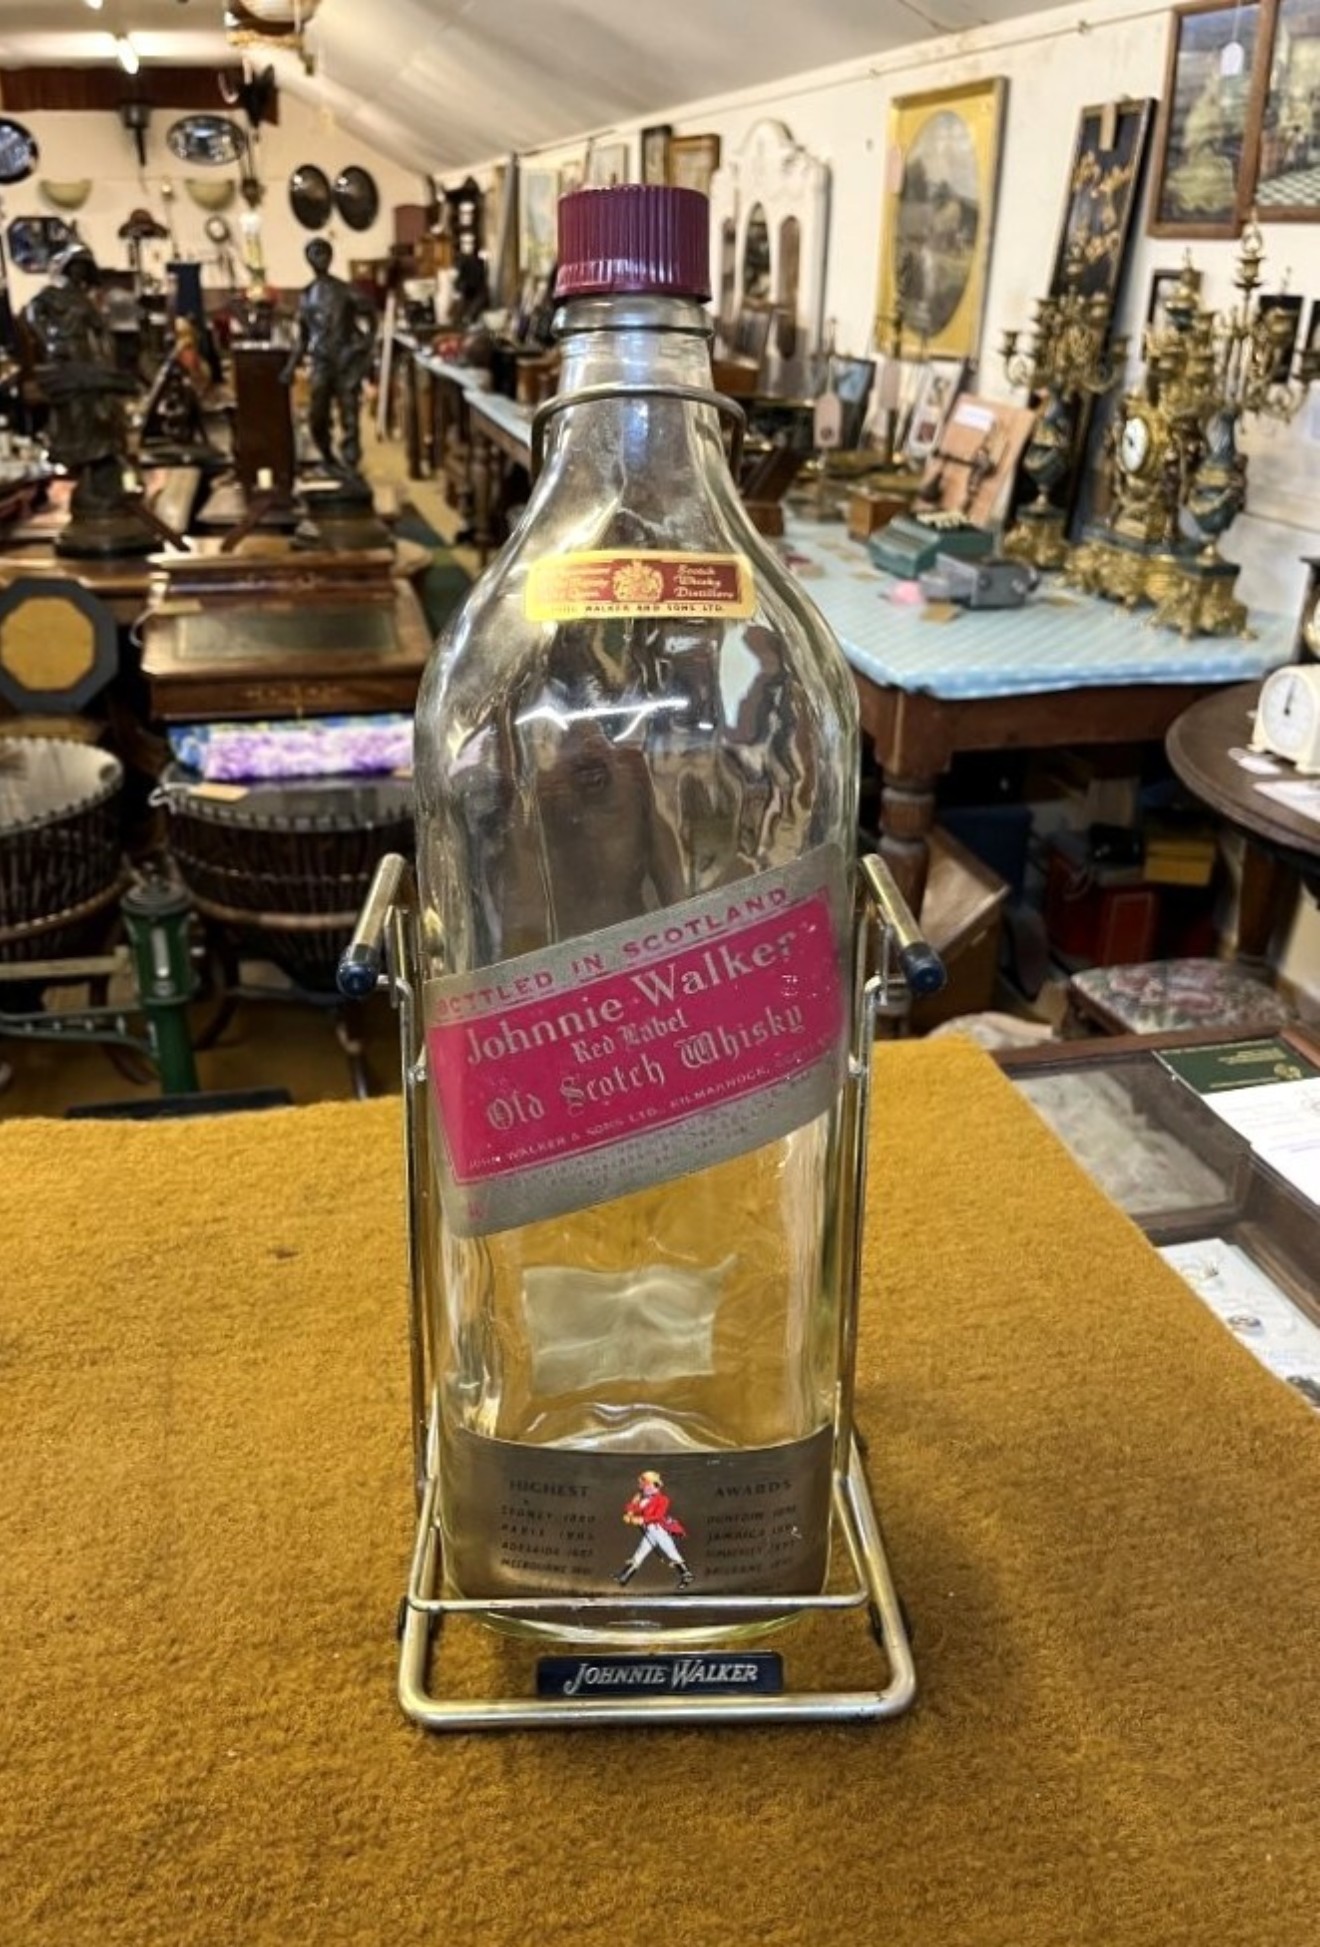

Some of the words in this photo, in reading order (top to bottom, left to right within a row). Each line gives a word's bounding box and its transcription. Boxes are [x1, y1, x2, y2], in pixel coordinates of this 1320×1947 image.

[673, 574, 721, 589] Whisky
[677, 564, 716, 575] Scotch
[573, 952, 605, 976] IN
[623, 887, 788, 958] SCOTLAND
[467, 996, 625, 1066] Johnnie
[629, 929, 797, 1008] Walker
[570, 1034, 615, 1064] Red
[617, 1008, 689, 1049] Label
[487, 1089, 546, 1131] Old
[560, 1054, 666, 1118] Scotch
[673, 1004, 806, 1069] Whisky
[507, 1135, 567, 1161] WALKER
[509, 1480, 590, 1498] HIGHEST
[714, 1479, 793, 1498] AWARDS
[563, 1662, 669, 1696] JOHNNIE
[671, 1658, 759, 1689] WALKER
